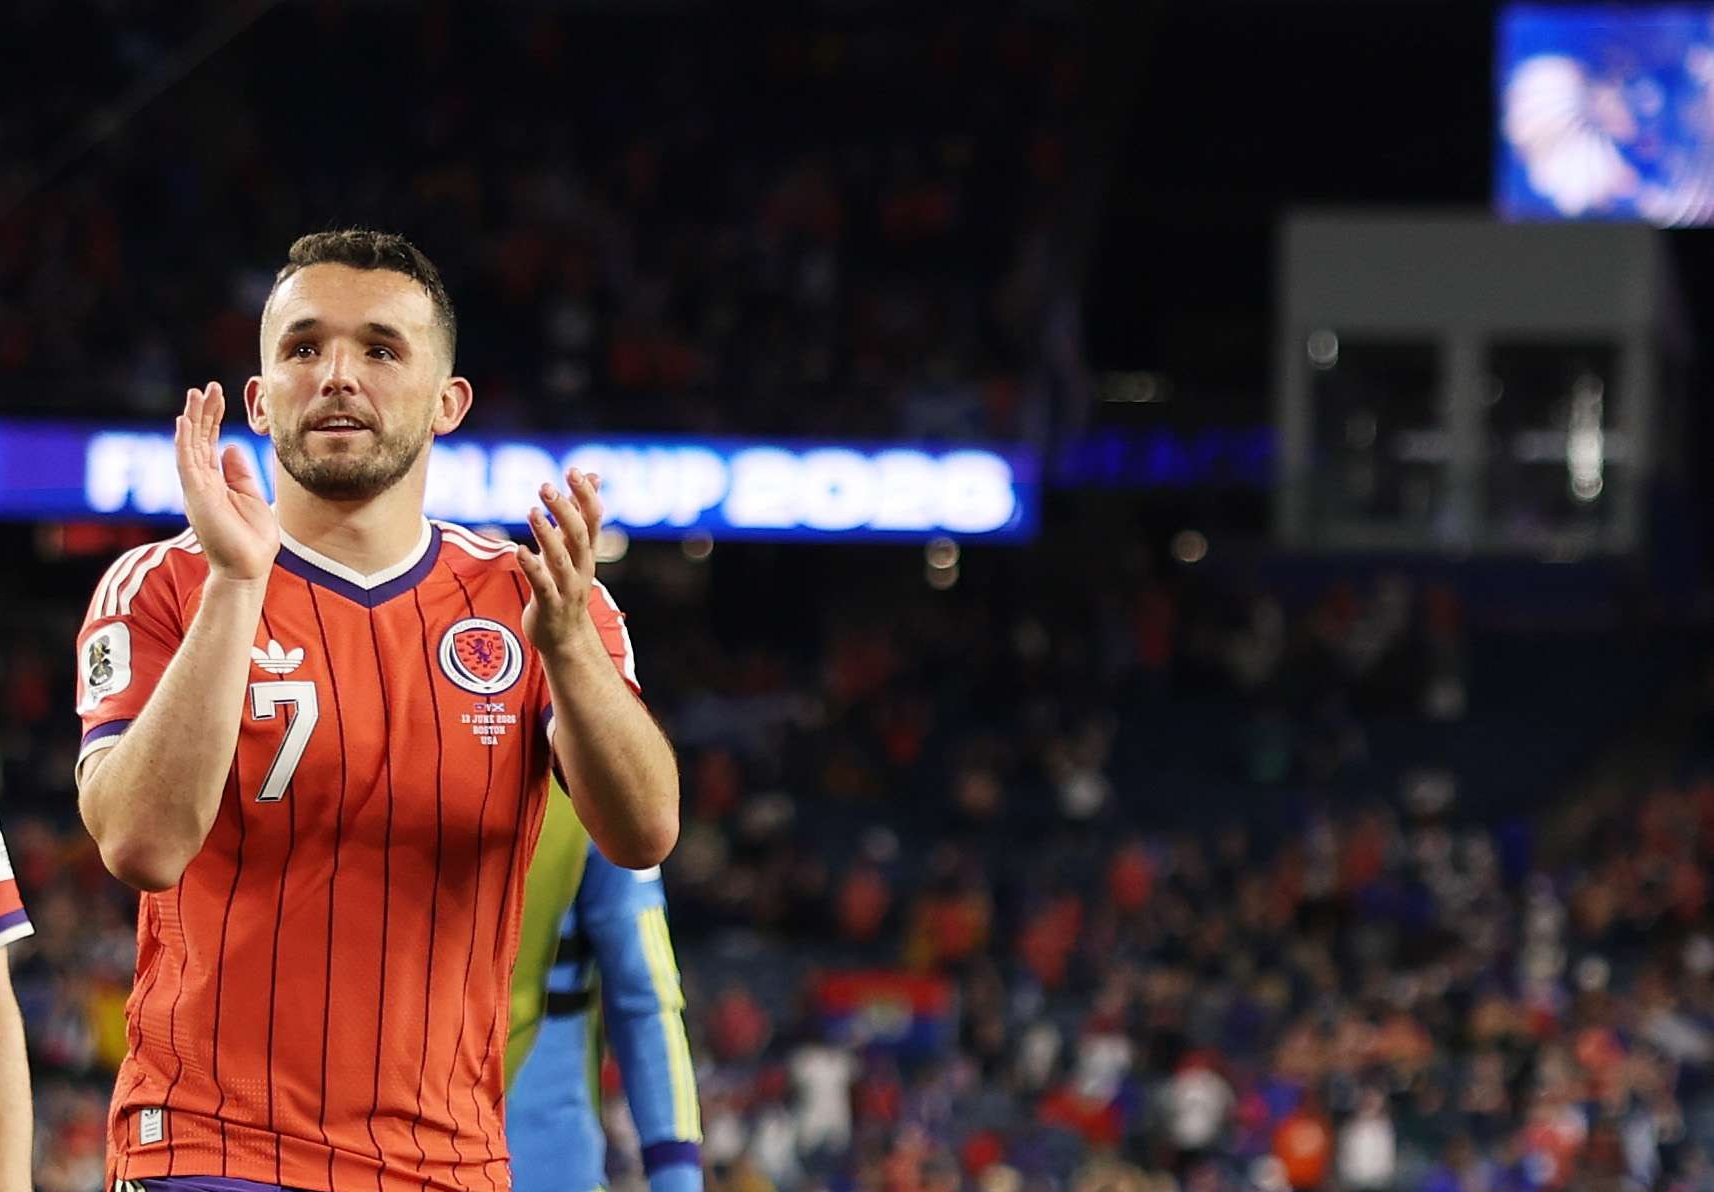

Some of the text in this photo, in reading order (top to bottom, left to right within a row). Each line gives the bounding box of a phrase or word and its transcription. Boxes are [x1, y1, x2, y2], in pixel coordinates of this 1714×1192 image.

[723, 447, 1016, 533] 2026
[472, 714, 494, 723] JUNE
[473, 725, 505, 734] BOSTON
[250, 681, 319, 802] 7
[481, 735, 498, 744] USA
